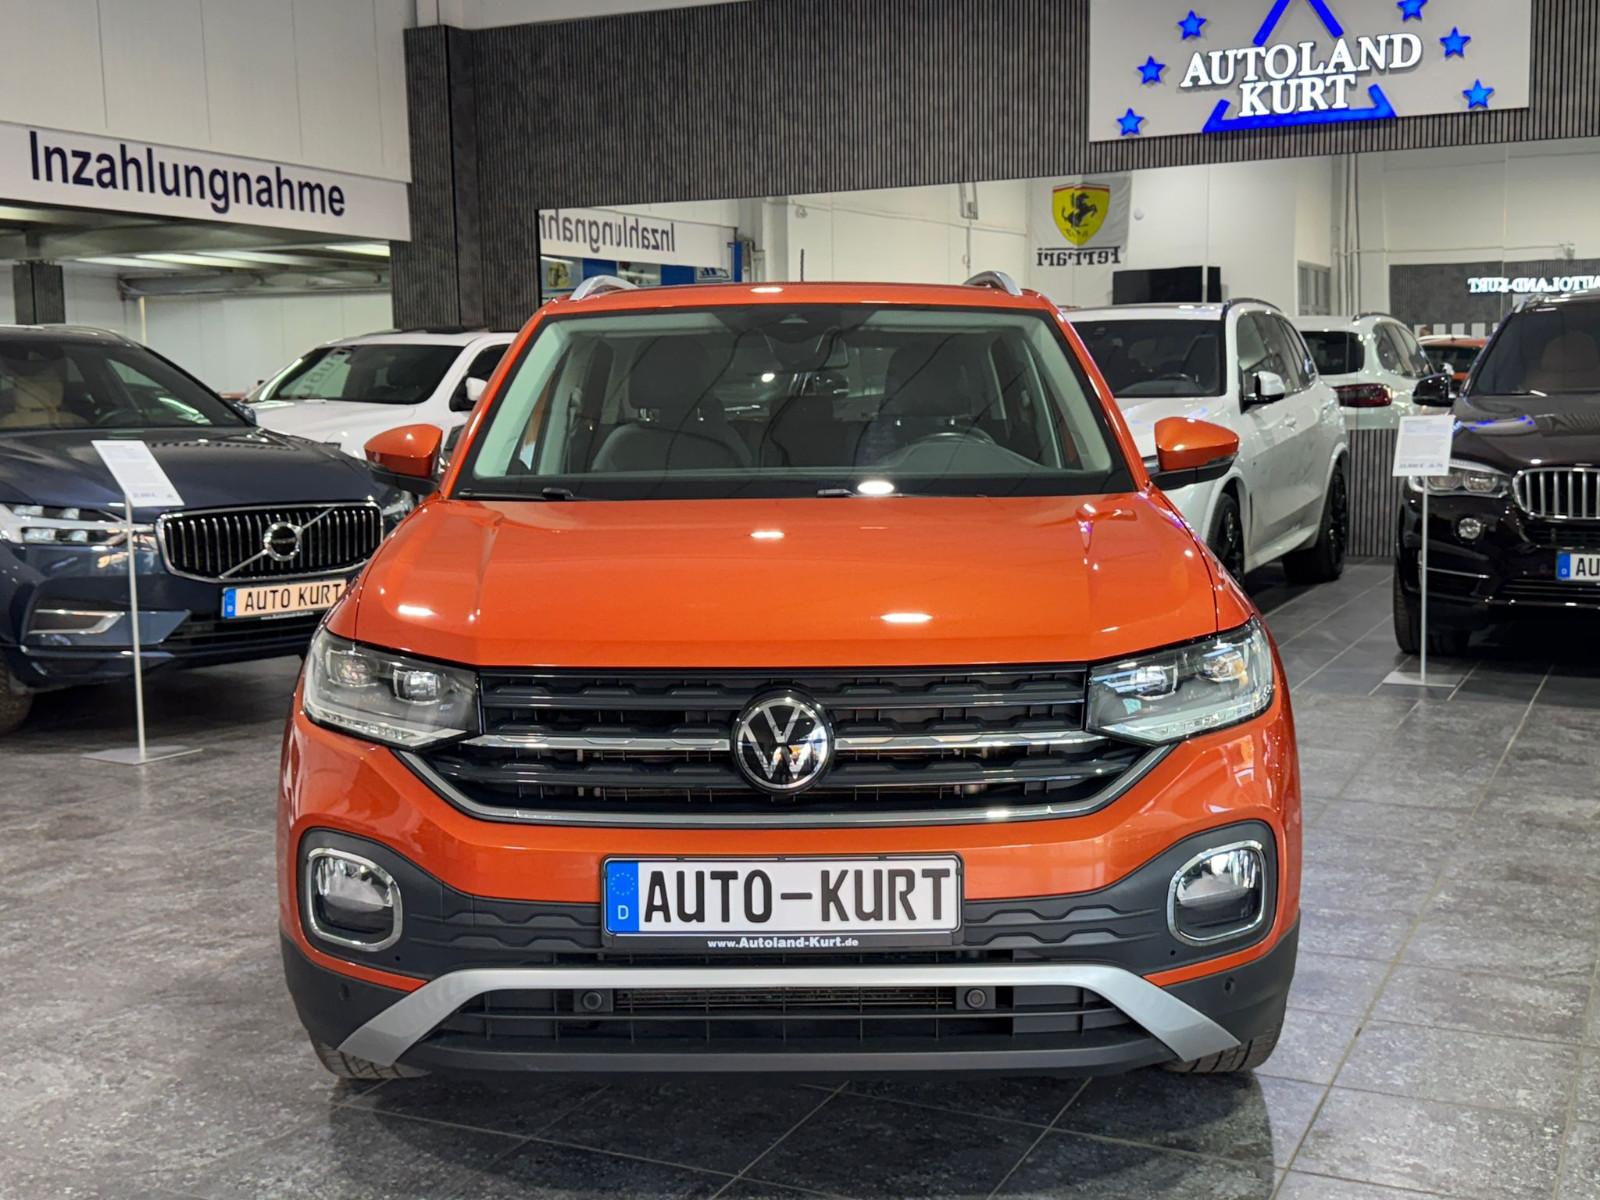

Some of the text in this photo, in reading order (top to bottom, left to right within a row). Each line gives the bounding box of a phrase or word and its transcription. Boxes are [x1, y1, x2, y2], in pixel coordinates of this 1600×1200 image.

[1180, 33, 1422, 88] AUTOLAND
[1239, 74, 1356, 117] KURT
[29, 130, 346, 217] Inzahlungnahme
[245, 583, 341, 611] AUTO KURT
[617, 904, 629, 920] D
[707, 936, 859, 948] www.Autoland-Kurt.de
